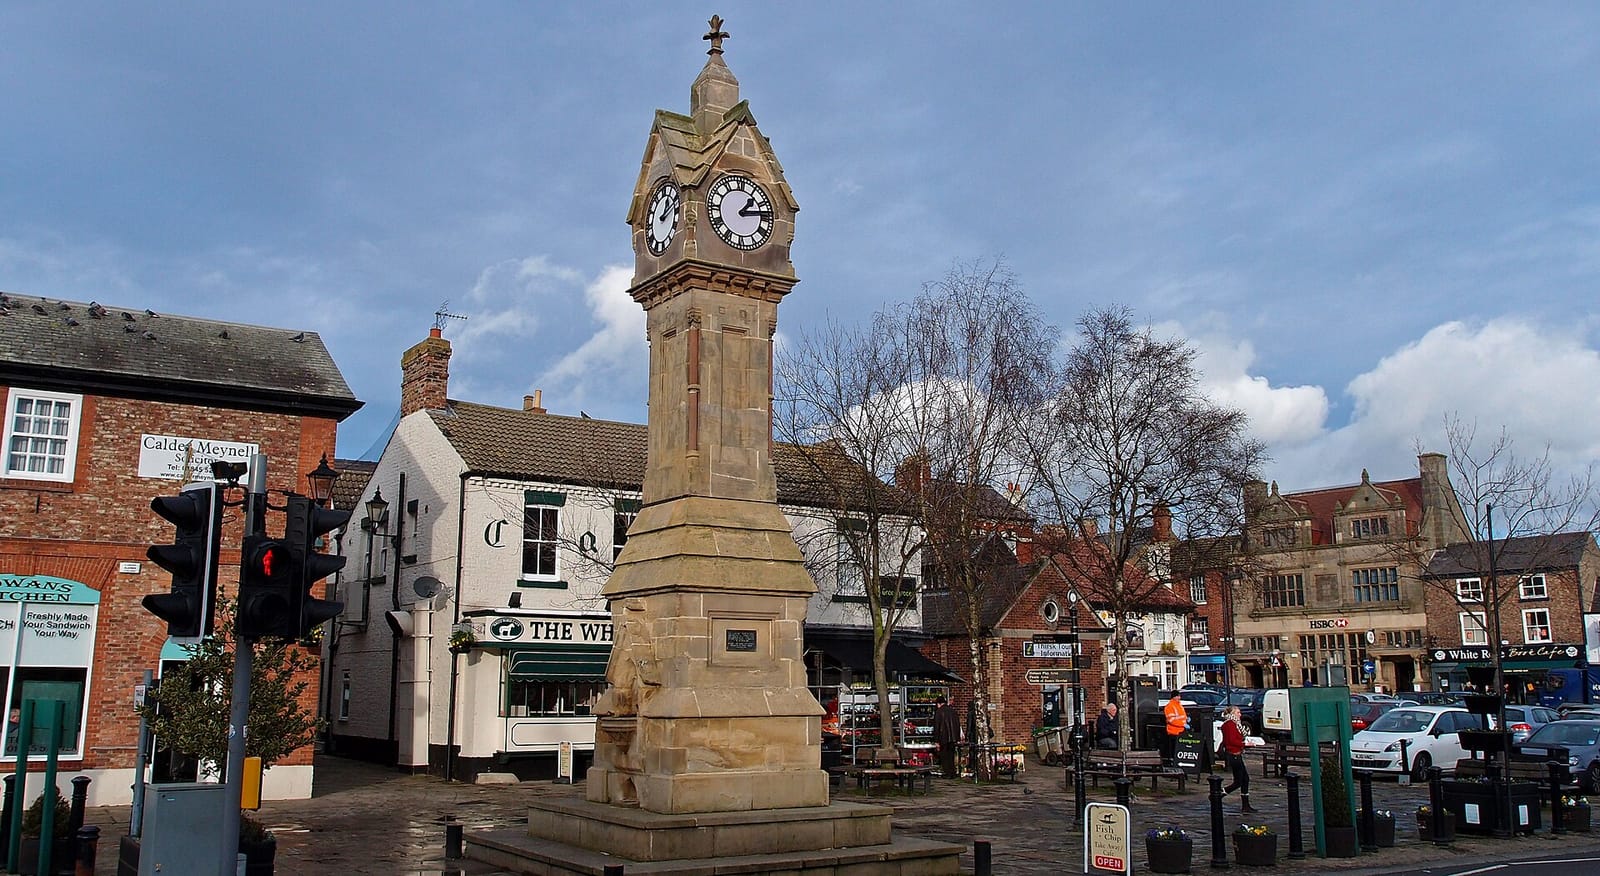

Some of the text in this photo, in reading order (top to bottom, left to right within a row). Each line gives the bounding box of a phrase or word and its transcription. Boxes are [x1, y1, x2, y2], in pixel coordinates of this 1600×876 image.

[196, 441, 254, 458] Meynell
[0, 578, 73, 592] WANS
[27, 612, 88, 622] Freshly Made
[23, 620, 91, 630] Your Sandwich
[1310, 620, 1335, 629] HSBC
[35, 629, 79, 640] Your Way
[530, 621, 573, 640] THE
[1449, 650, 1479, 660] White
[1177, 751, 1199, 760] OPEN
[1095, 824, 1114, 834] Fish
[1104, 833, 1122, 843] Chip
[1097, 857, 1121, 868] OPEN
